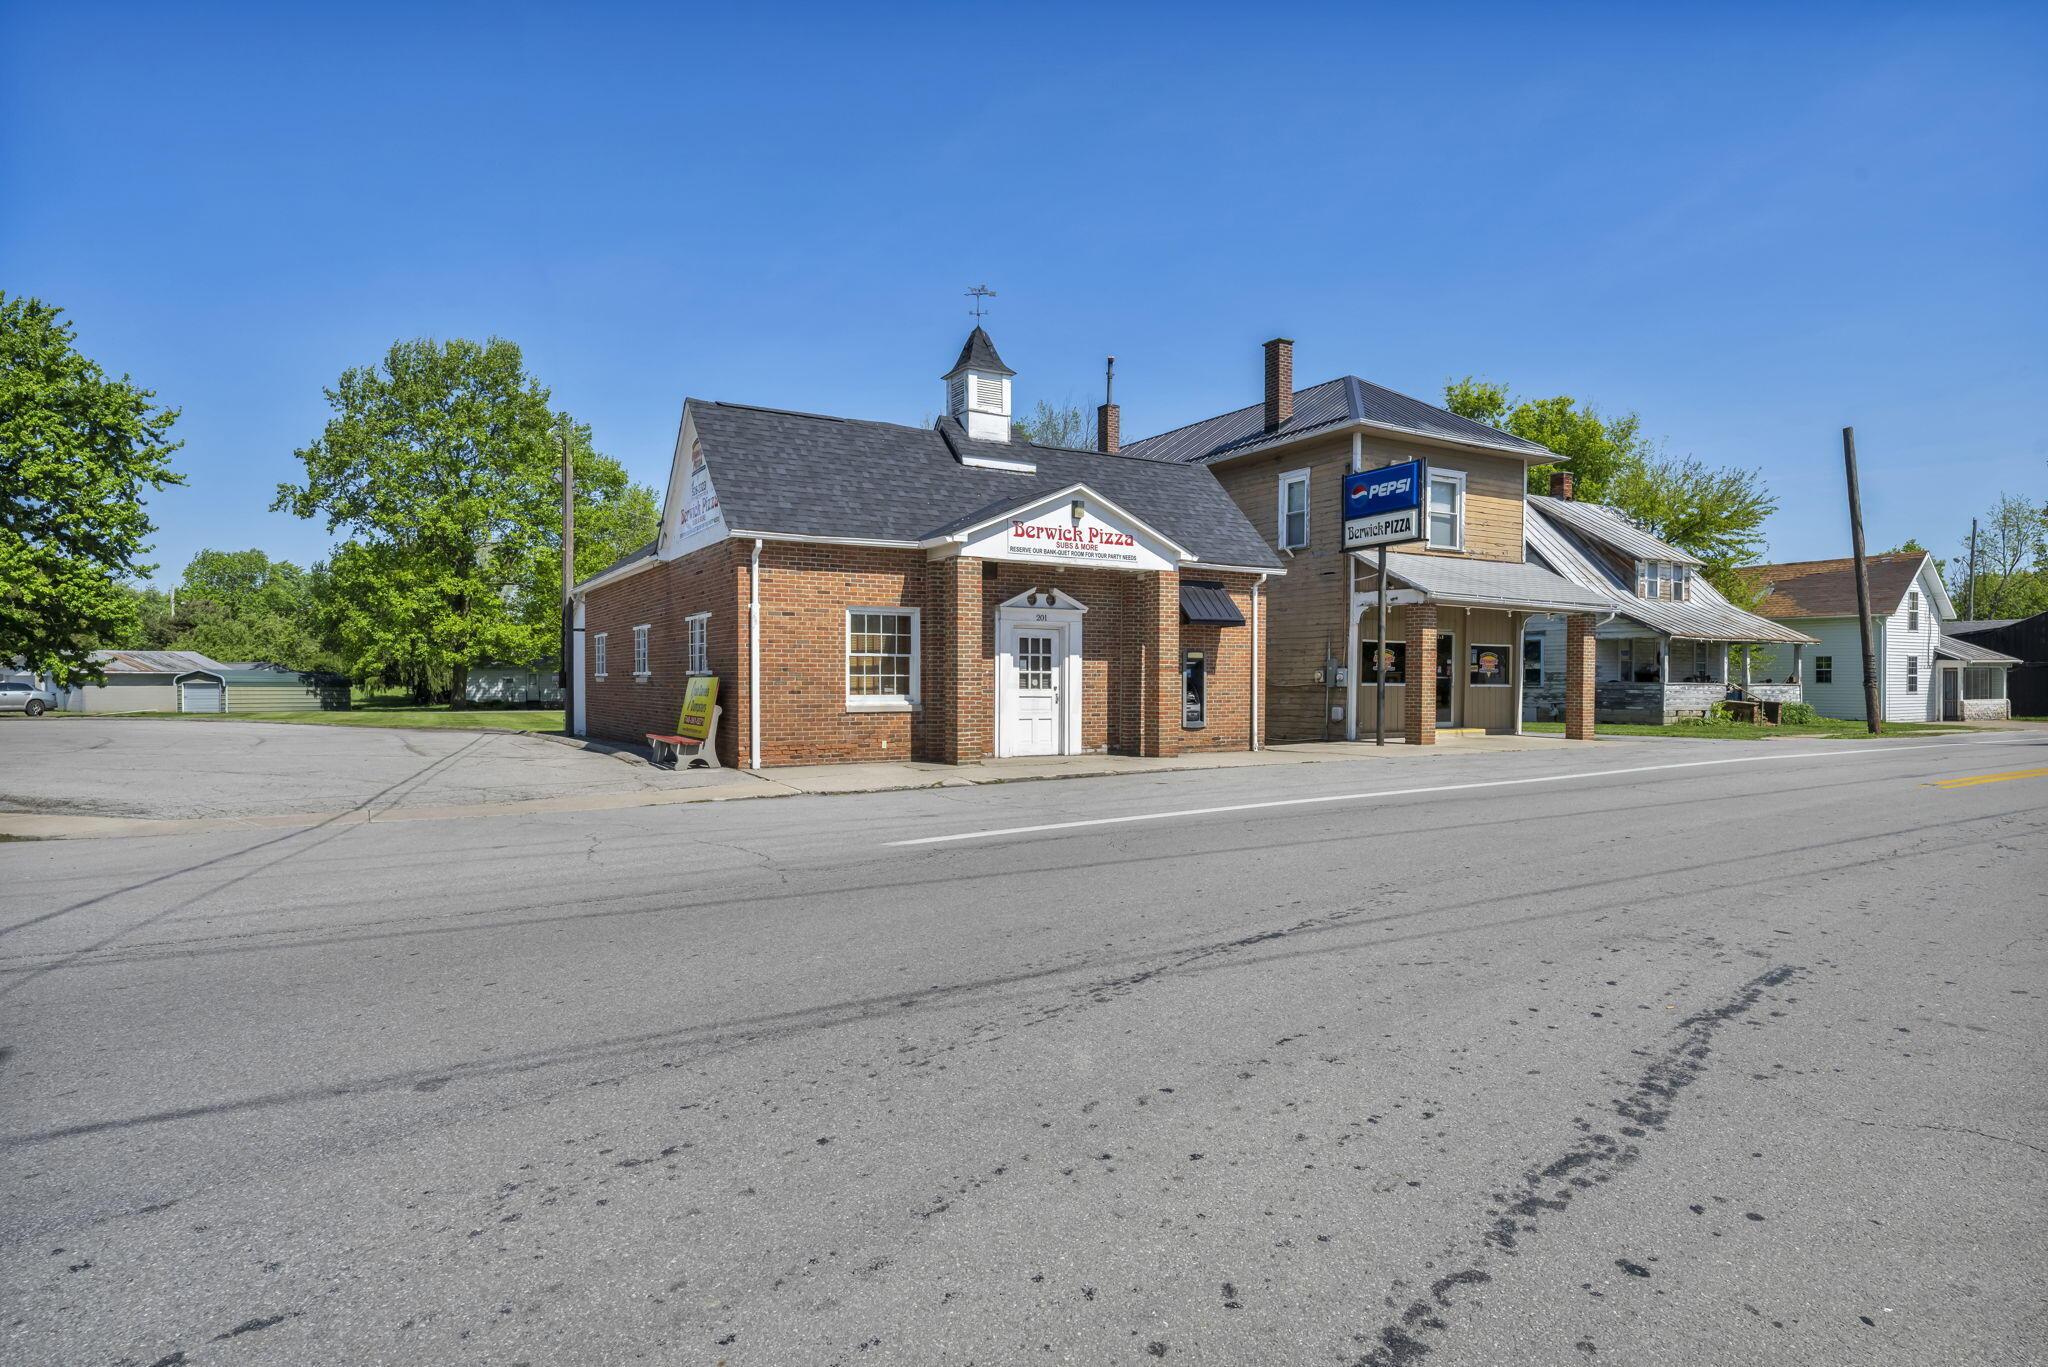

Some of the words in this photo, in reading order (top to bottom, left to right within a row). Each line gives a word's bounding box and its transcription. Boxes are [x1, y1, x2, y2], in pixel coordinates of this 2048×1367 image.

[1369, 478, 1411, 499] PEPSI
[1012, 521, 1083, 542] Berwick
[1088, 527, 1134, 546] Pizza
[1348, 522, 1384, 540] Berwick
[1384, 518, 1411, 535] PIZZA
[1081, 543, 1098, 551] MORE
